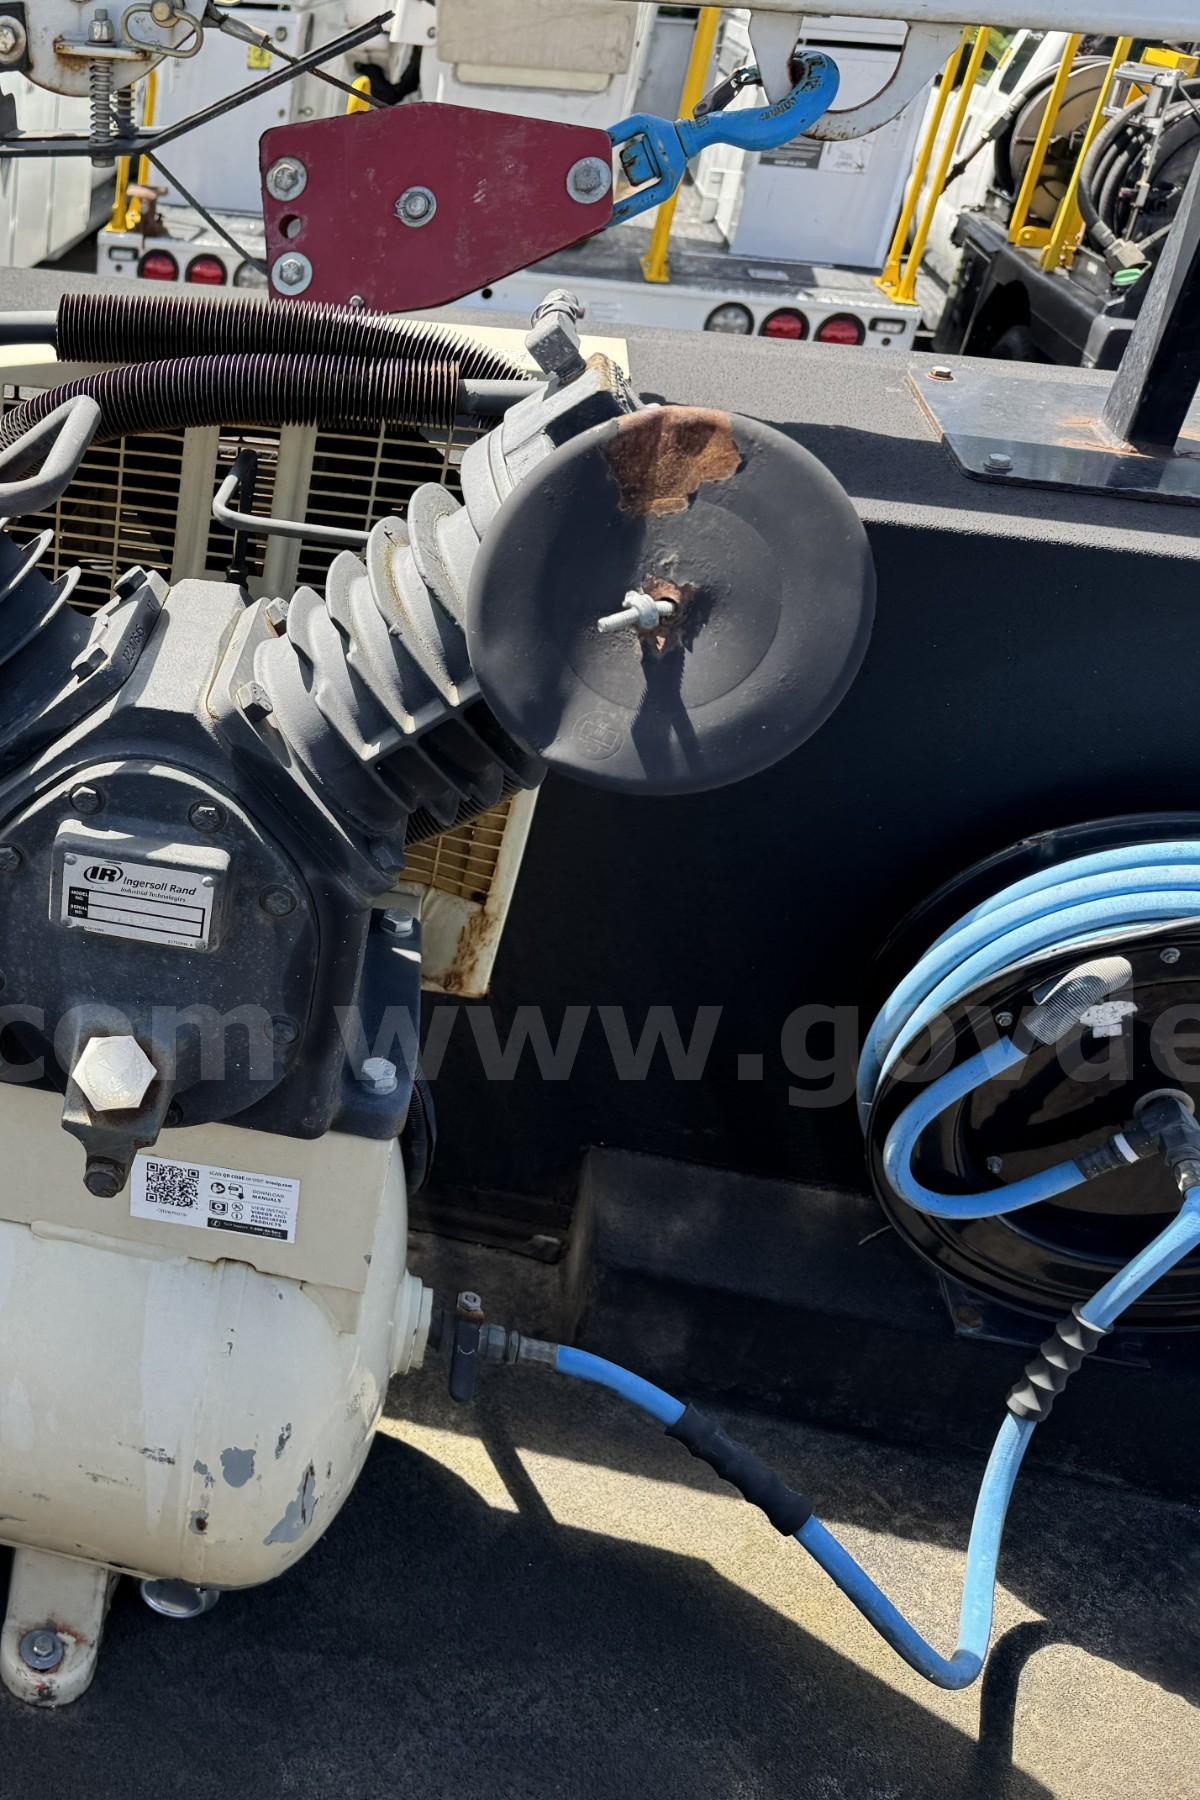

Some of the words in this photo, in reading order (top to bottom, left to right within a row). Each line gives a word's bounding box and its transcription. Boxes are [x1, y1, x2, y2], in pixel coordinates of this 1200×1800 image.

[120, 887, 149, 897] Industrial
[149, 891, 186, 903] Technologies
[123, 876, 168, 892] Ingersoll
[169, 885, 197, 896] Rand
